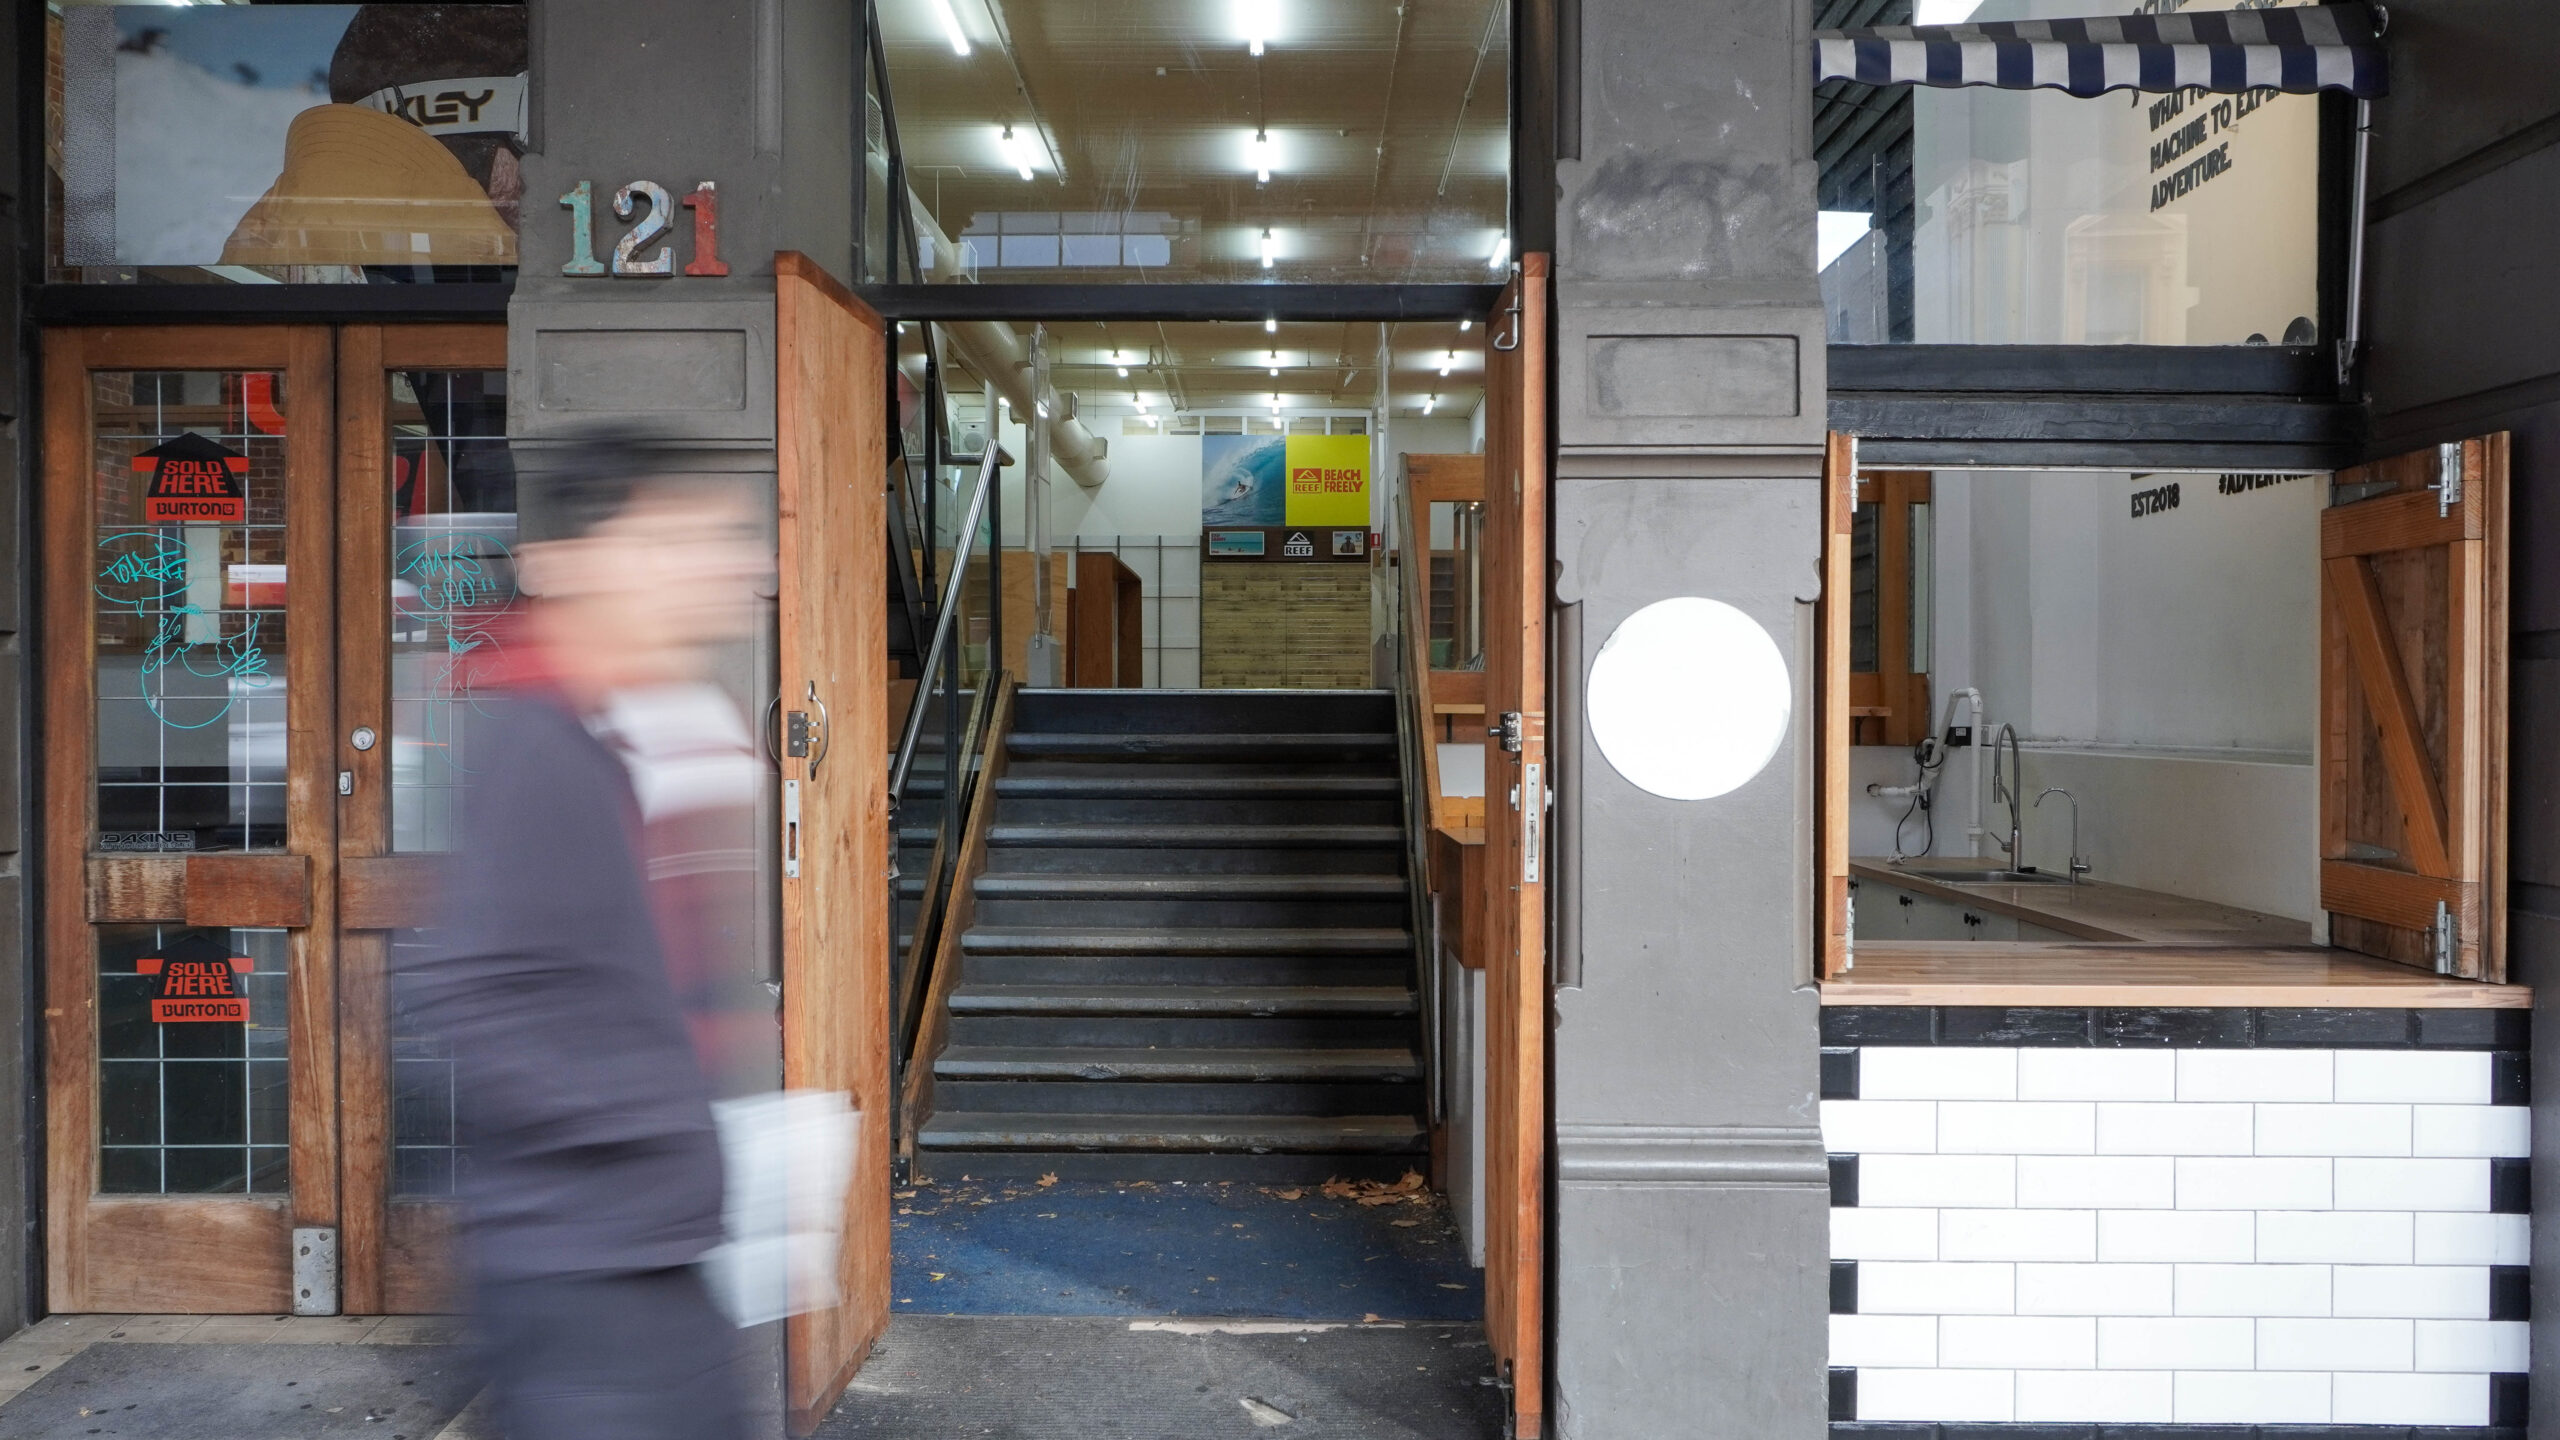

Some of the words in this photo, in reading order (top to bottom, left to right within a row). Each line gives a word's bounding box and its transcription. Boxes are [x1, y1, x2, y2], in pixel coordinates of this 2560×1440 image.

[2149, 92, 2184, 132] WHAT
[2150, 113, 2207, 173] MACHINE
[2211, 99, 2231, 134] TO
[2150, 141, 2232, 212] ADVENTURE.
[559, 180, 729, 277] 121
[163, 461, 223, 475] SOLD
[1324, 469, 1361, 480] BEACH
[158, 475, 228, 494] HERE
[1294, 483, 1320, 492] REEF
[1324, 481, 1363, 493] FREELY
[2131, 482, 2180, 518] EST2018
[156, 502, 222, 516] BURTON
[1285, 546, 1313, 555] REEF
[102, 832, 192, 843] DAKINE
[168, 962, 228, 976] SOLD
[163, 976, 234, 995] HERE
[161, 1003, 228, 1017] BURTON
